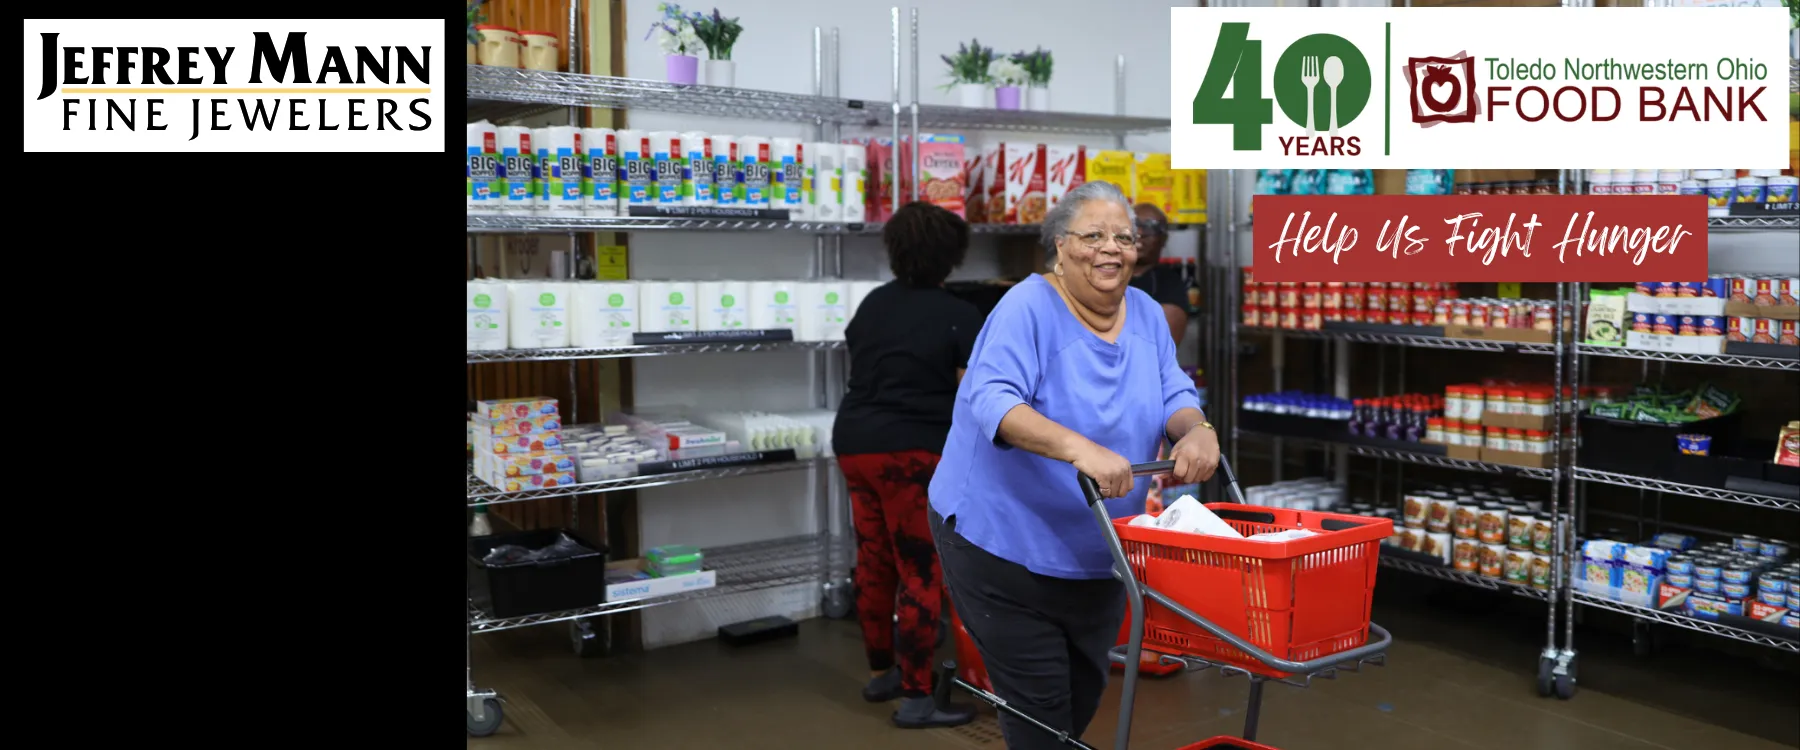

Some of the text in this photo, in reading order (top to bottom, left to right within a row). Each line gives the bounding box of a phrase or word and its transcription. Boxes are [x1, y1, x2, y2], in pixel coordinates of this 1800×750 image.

[471, 157, 495, 170] BIG
[507, 158, 531, 170] BIG
[593, 158, 616, 171] BIG
[629, 161, 650, 174] BIG
[659, 162, 680, 174] BIG
[693, 160, 714, 173] BIG
[746, 165, 768, 178] BIG
[612, 585, 649, 597] sistema
